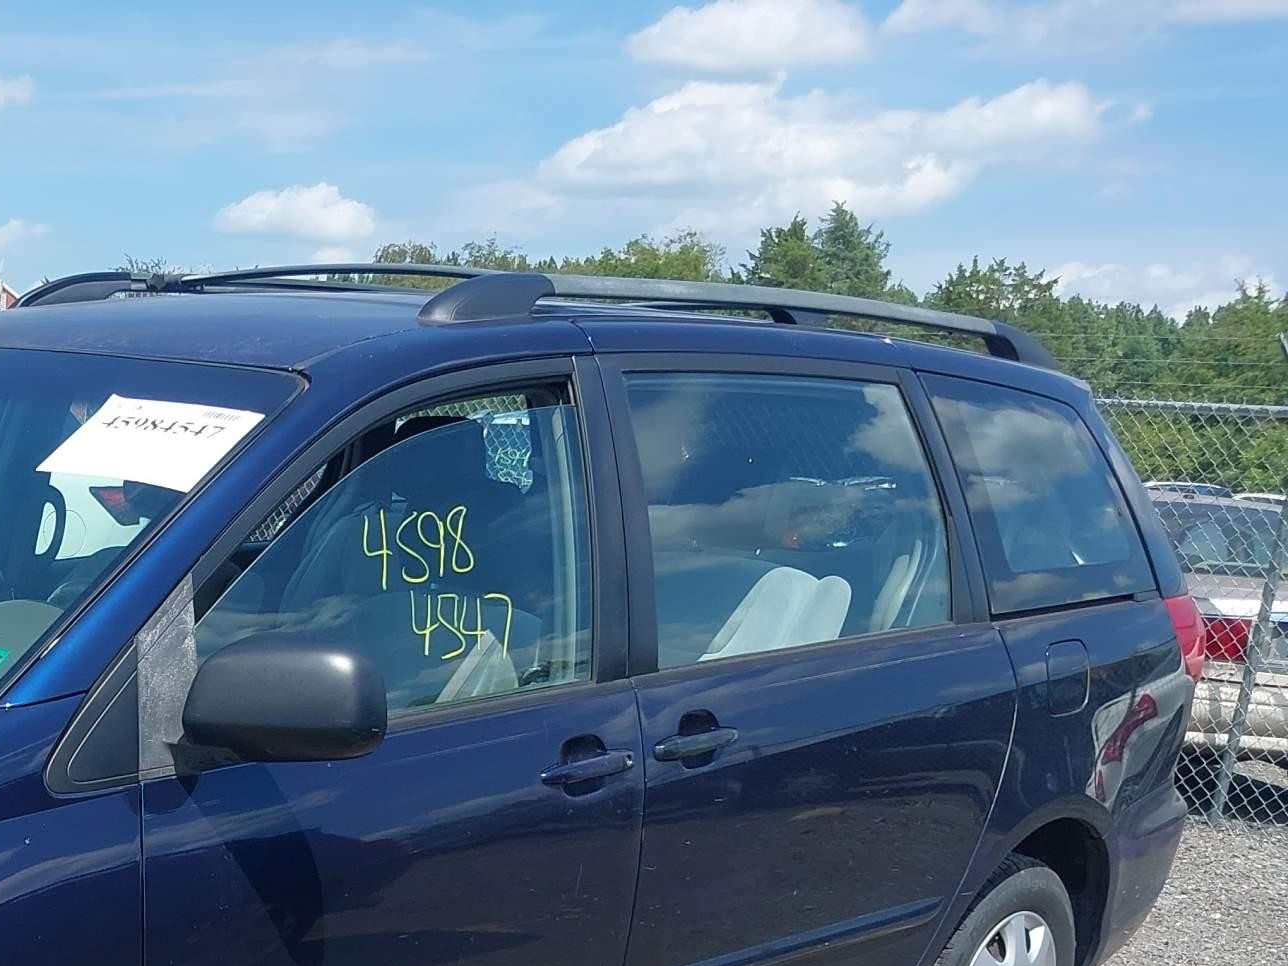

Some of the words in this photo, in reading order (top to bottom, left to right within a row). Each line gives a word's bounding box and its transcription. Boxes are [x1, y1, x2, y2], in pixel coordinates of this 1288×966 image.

[102, 415, 225, 439] 45984547
[363, 506, 475, 590] 4598
[410, 590, 513, 660] 4547
